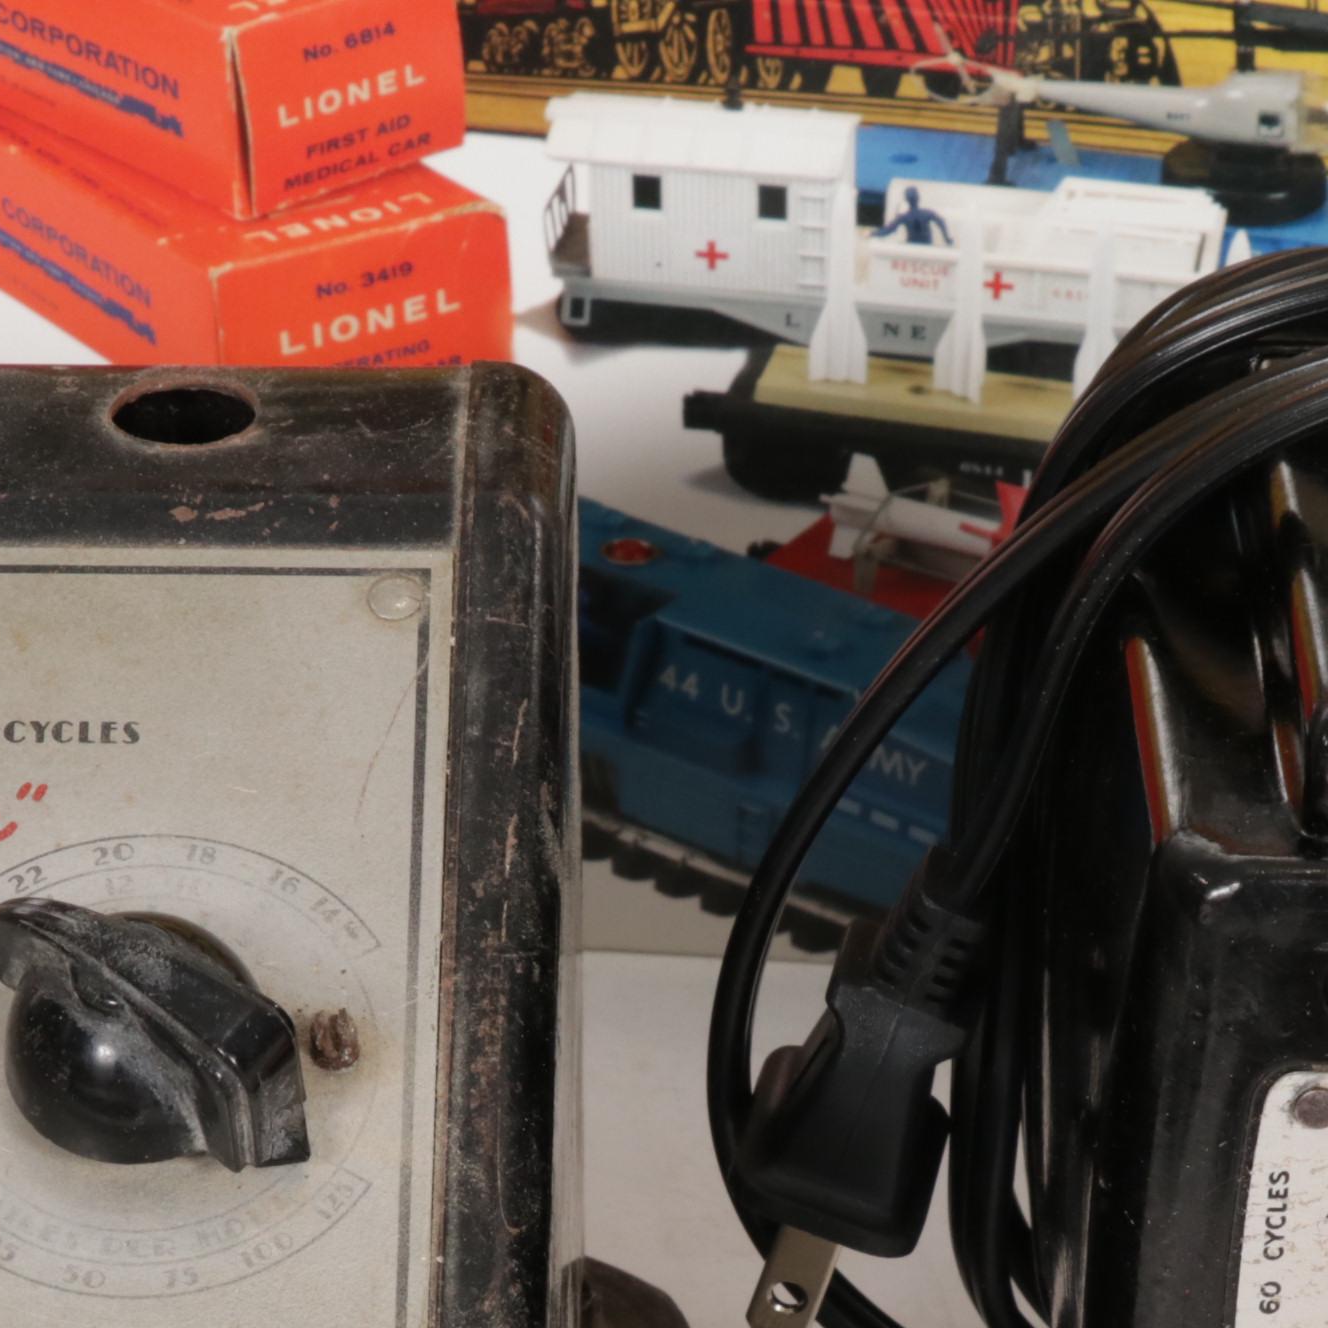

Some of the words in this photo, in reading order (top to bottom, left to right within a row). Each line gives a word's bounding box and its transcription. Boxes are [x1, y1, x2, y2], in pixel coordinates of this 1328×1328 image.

[343, 21, 397, 50] 6814
[277, 64, 427, 129] LIONEL
[305, 127, 369, 159] FIRST
[376, 114, 412, 136] AID
[283, 152, 378, 192] MEDICAL
[388, 133, 432, 157] CAR
[242, 191, 434, 242] LIONEL
[0, 197, 153, 308] CORPORATION
[362, 261, 414, 289] 3419
[279, 288, 462, 357] LIONEL
[658, 664, 701, 700] 44
[3, 720, 142, 744] CYCLES
[92, 843, 135, 866] 20
[184, 845, 217, 866] 18
[8, 866, 48, 894] 22
[269, 868, 301, 895] 16
[318, 1183, 356, 1221] 125
[1263, 1169, 1291, 1261] CYCLES
[240, 1232, 294, 1269] 100
[63, 1266, 107, 1290] 50
[160, 1269, 201, 1290] 75
[1260, 1280, 1283, 1316] 60
